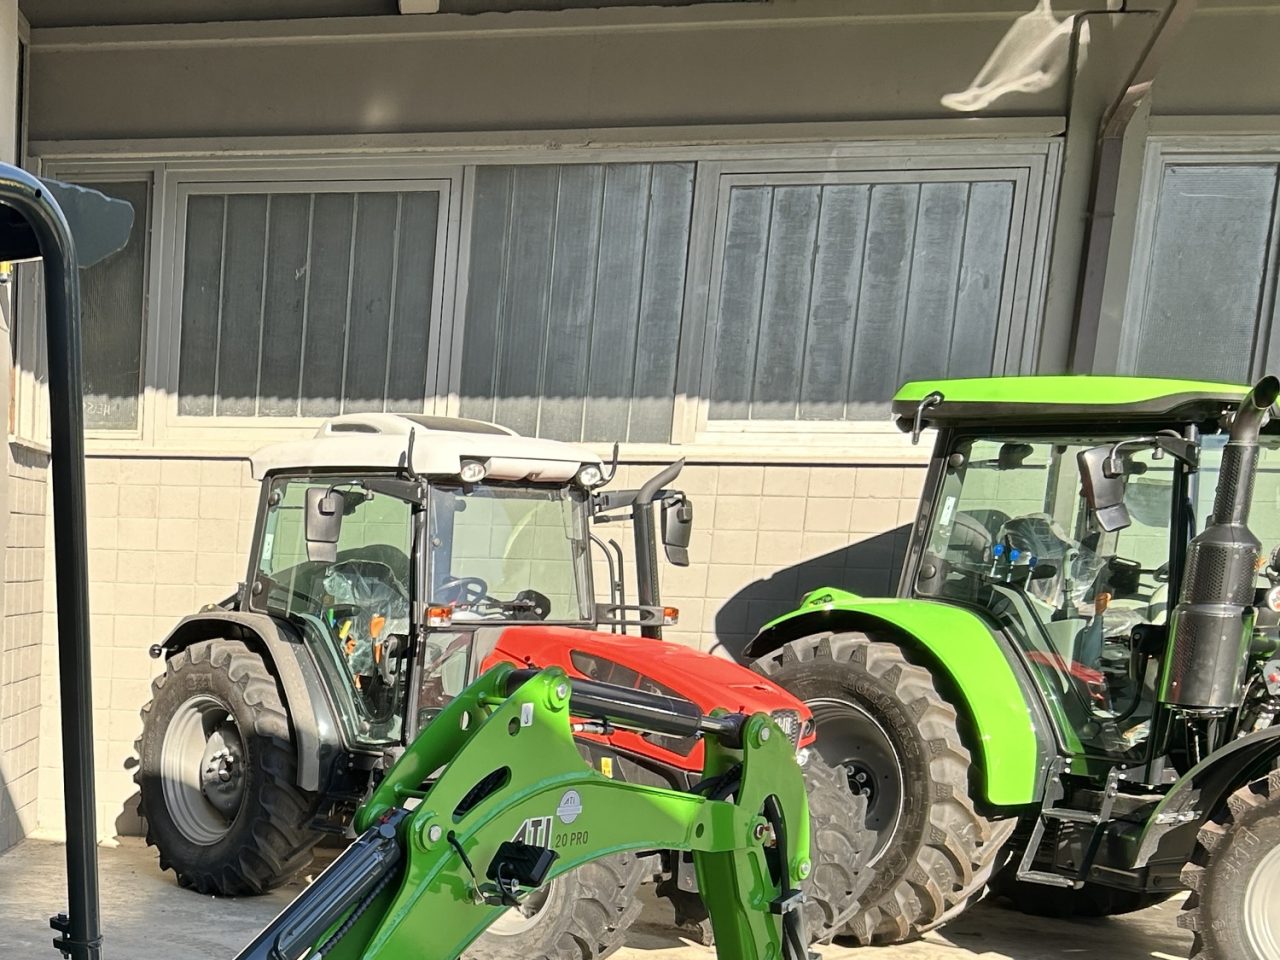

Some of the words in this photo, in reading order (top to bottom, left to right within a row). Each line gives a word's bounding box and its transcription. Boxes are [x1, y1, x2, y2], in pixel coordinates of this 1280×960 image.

[511, 816, 553, 849] ATI
[555, 832, 568, 848] 20
[570, 830, 589, 846] PRO
